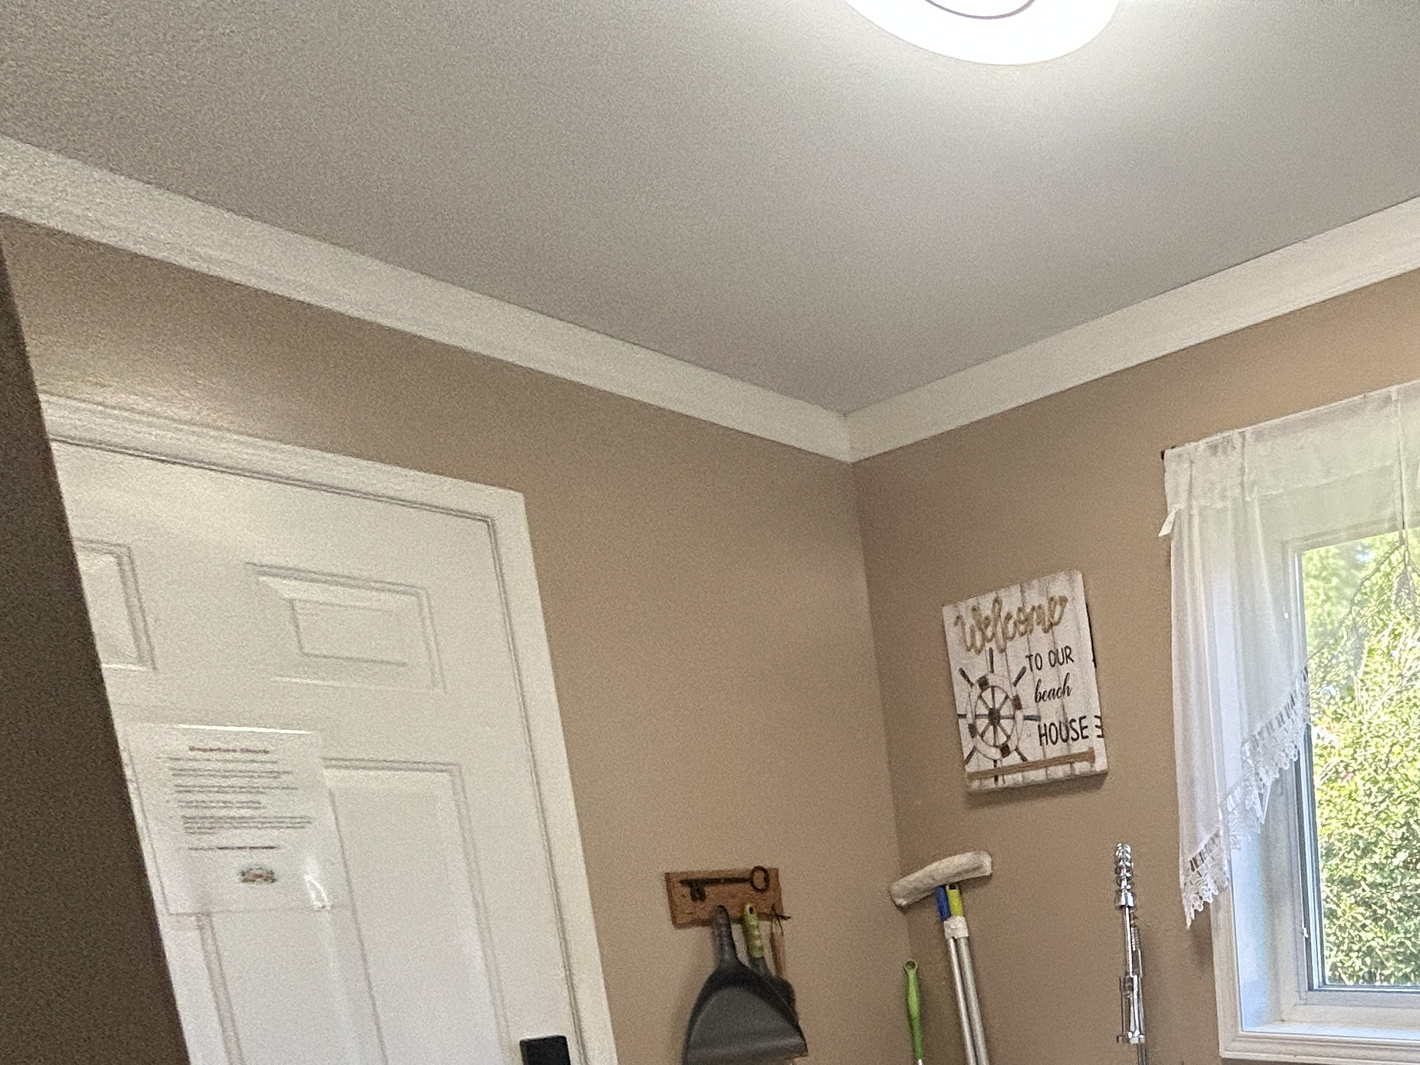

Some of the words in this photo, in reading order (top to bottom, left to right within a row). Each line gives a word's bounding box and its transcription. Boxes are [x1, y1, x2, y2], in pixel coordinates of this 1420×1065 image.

[953, 595, 1069, 656] Welcome
[1025, 653, 1044, 674] TO
[1048, 645, 1075, 668] OUR
[1034, 672, 1073, 704] beach
[1038, 714, 1089, 747] HOUSE
